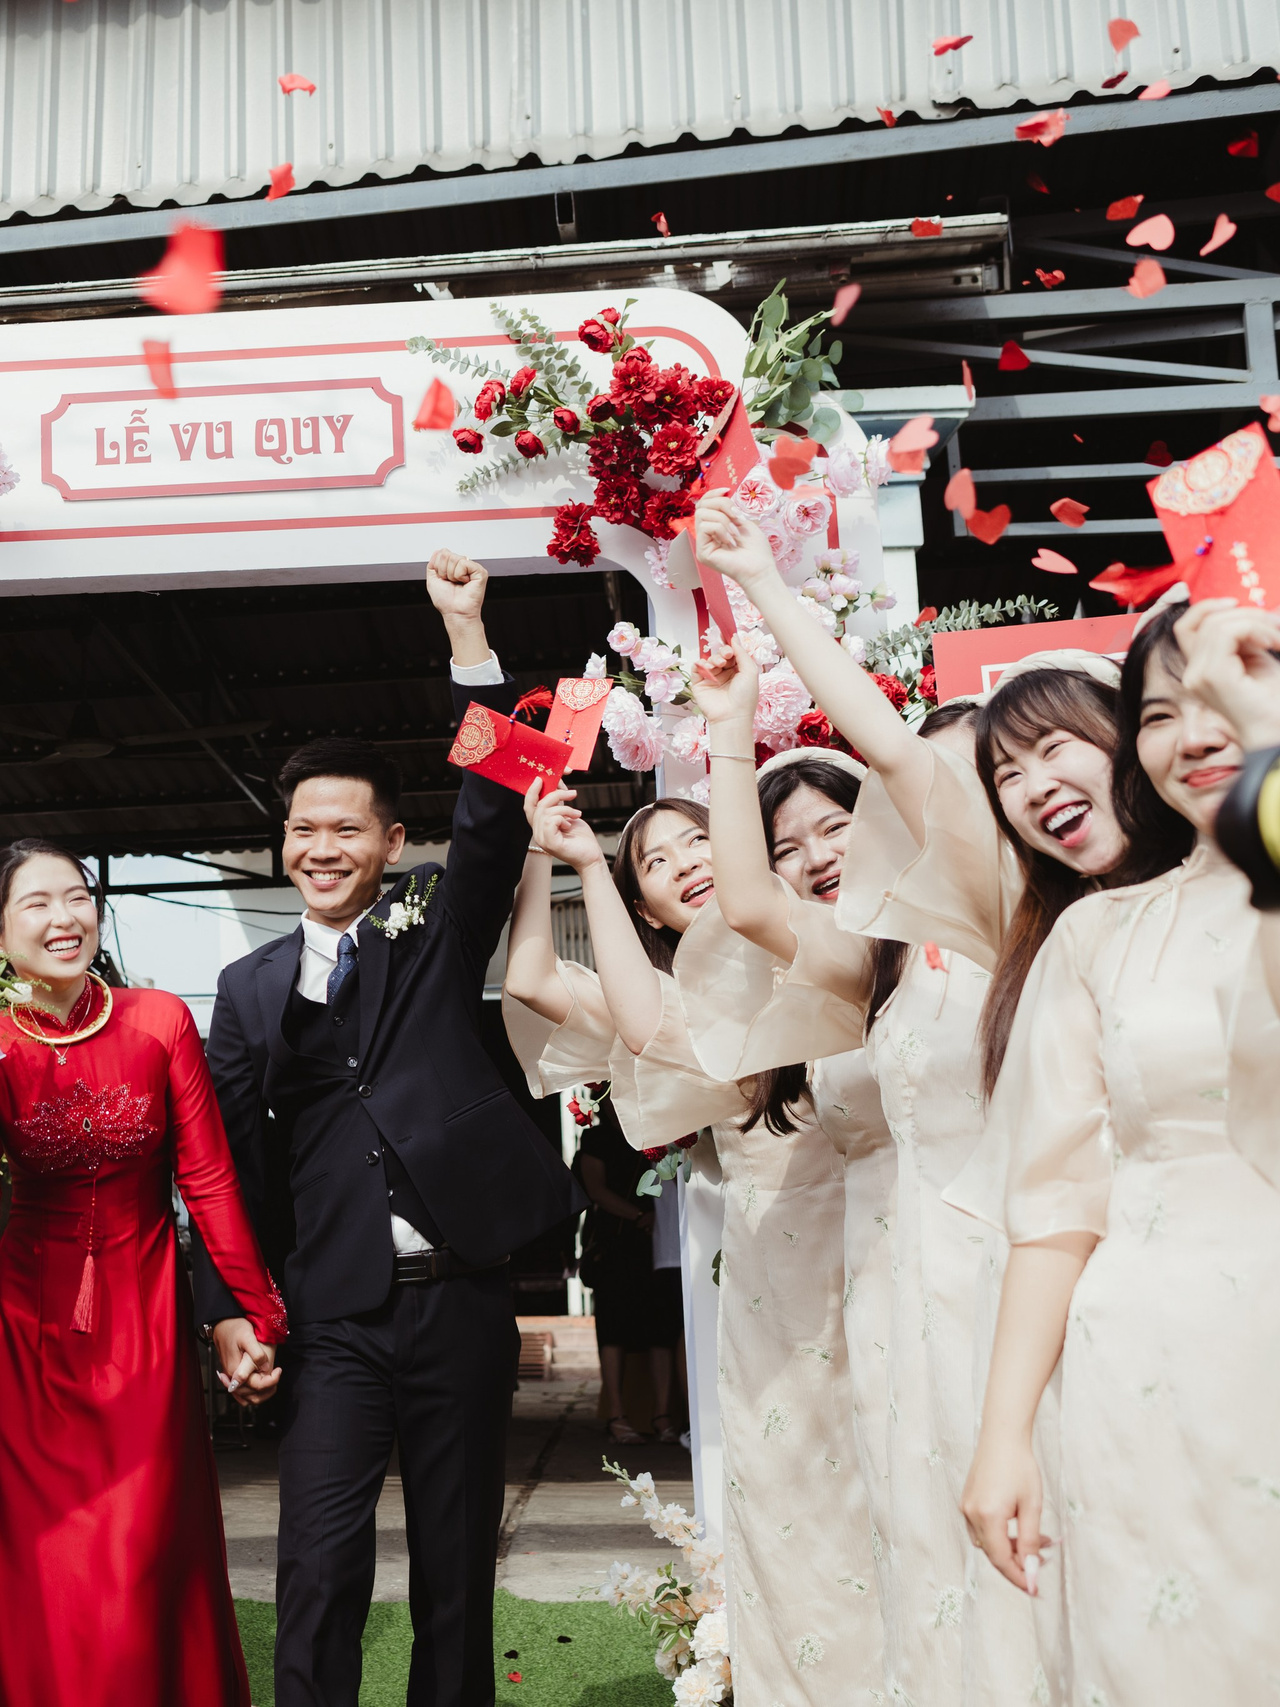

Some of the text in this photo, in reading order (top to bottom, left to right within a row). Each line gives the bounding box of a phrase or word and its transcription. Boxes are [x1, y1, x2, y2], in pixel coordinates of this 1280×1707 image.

[95, 408, 354, 466] LỄ VU QUY
